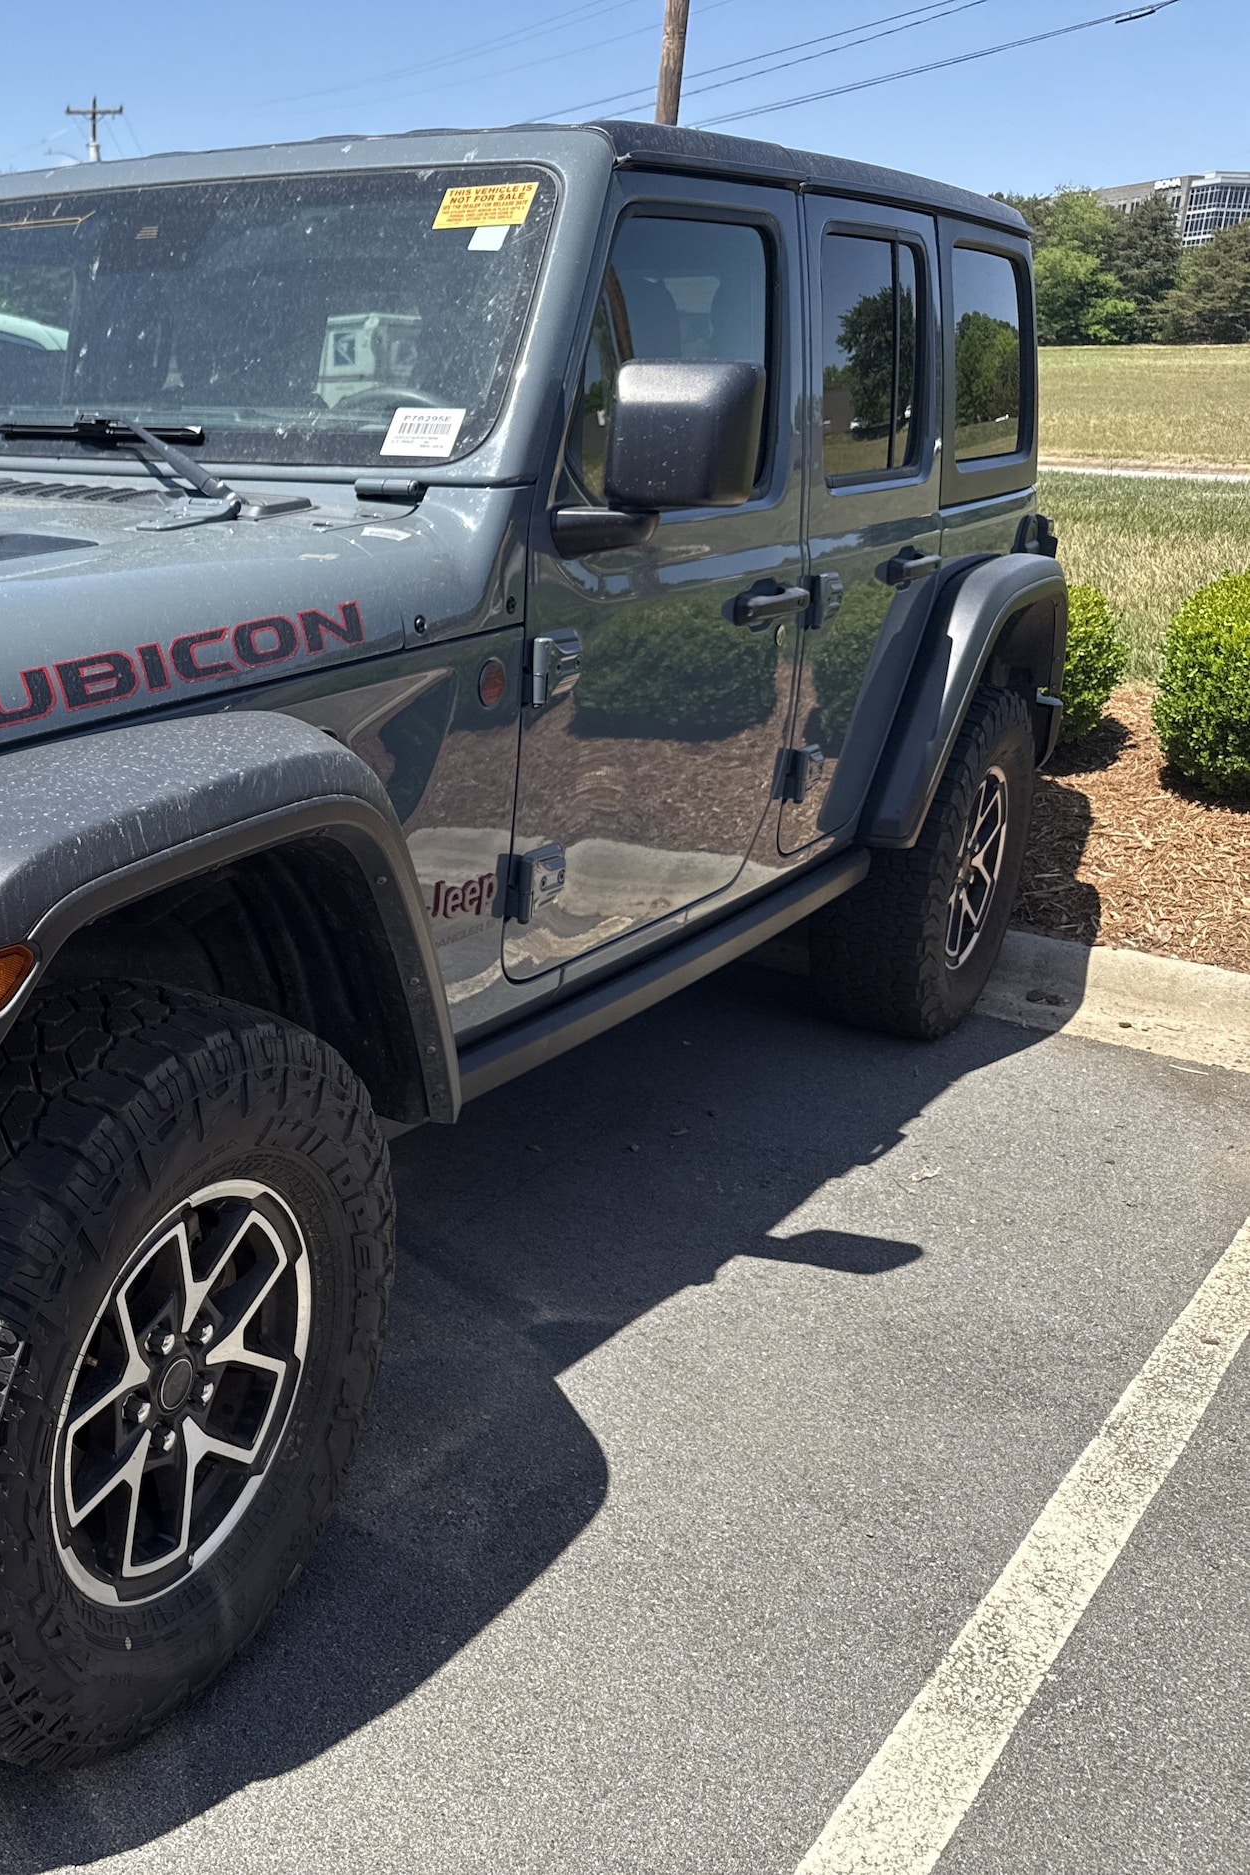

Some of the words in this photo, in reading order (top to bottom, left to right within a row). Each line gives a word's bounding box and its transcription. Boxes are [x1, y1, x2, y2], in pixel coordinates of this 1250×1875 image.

[449, 188, 471, 196] THIS
[475, 185, 519, 194] VEHICLE
[450, 195, 472, 203] NOT
[473, 194, 495, 202] FOR
[497, 192, 526, 201] SALE
[431, 872, 498, 919] Jeep
